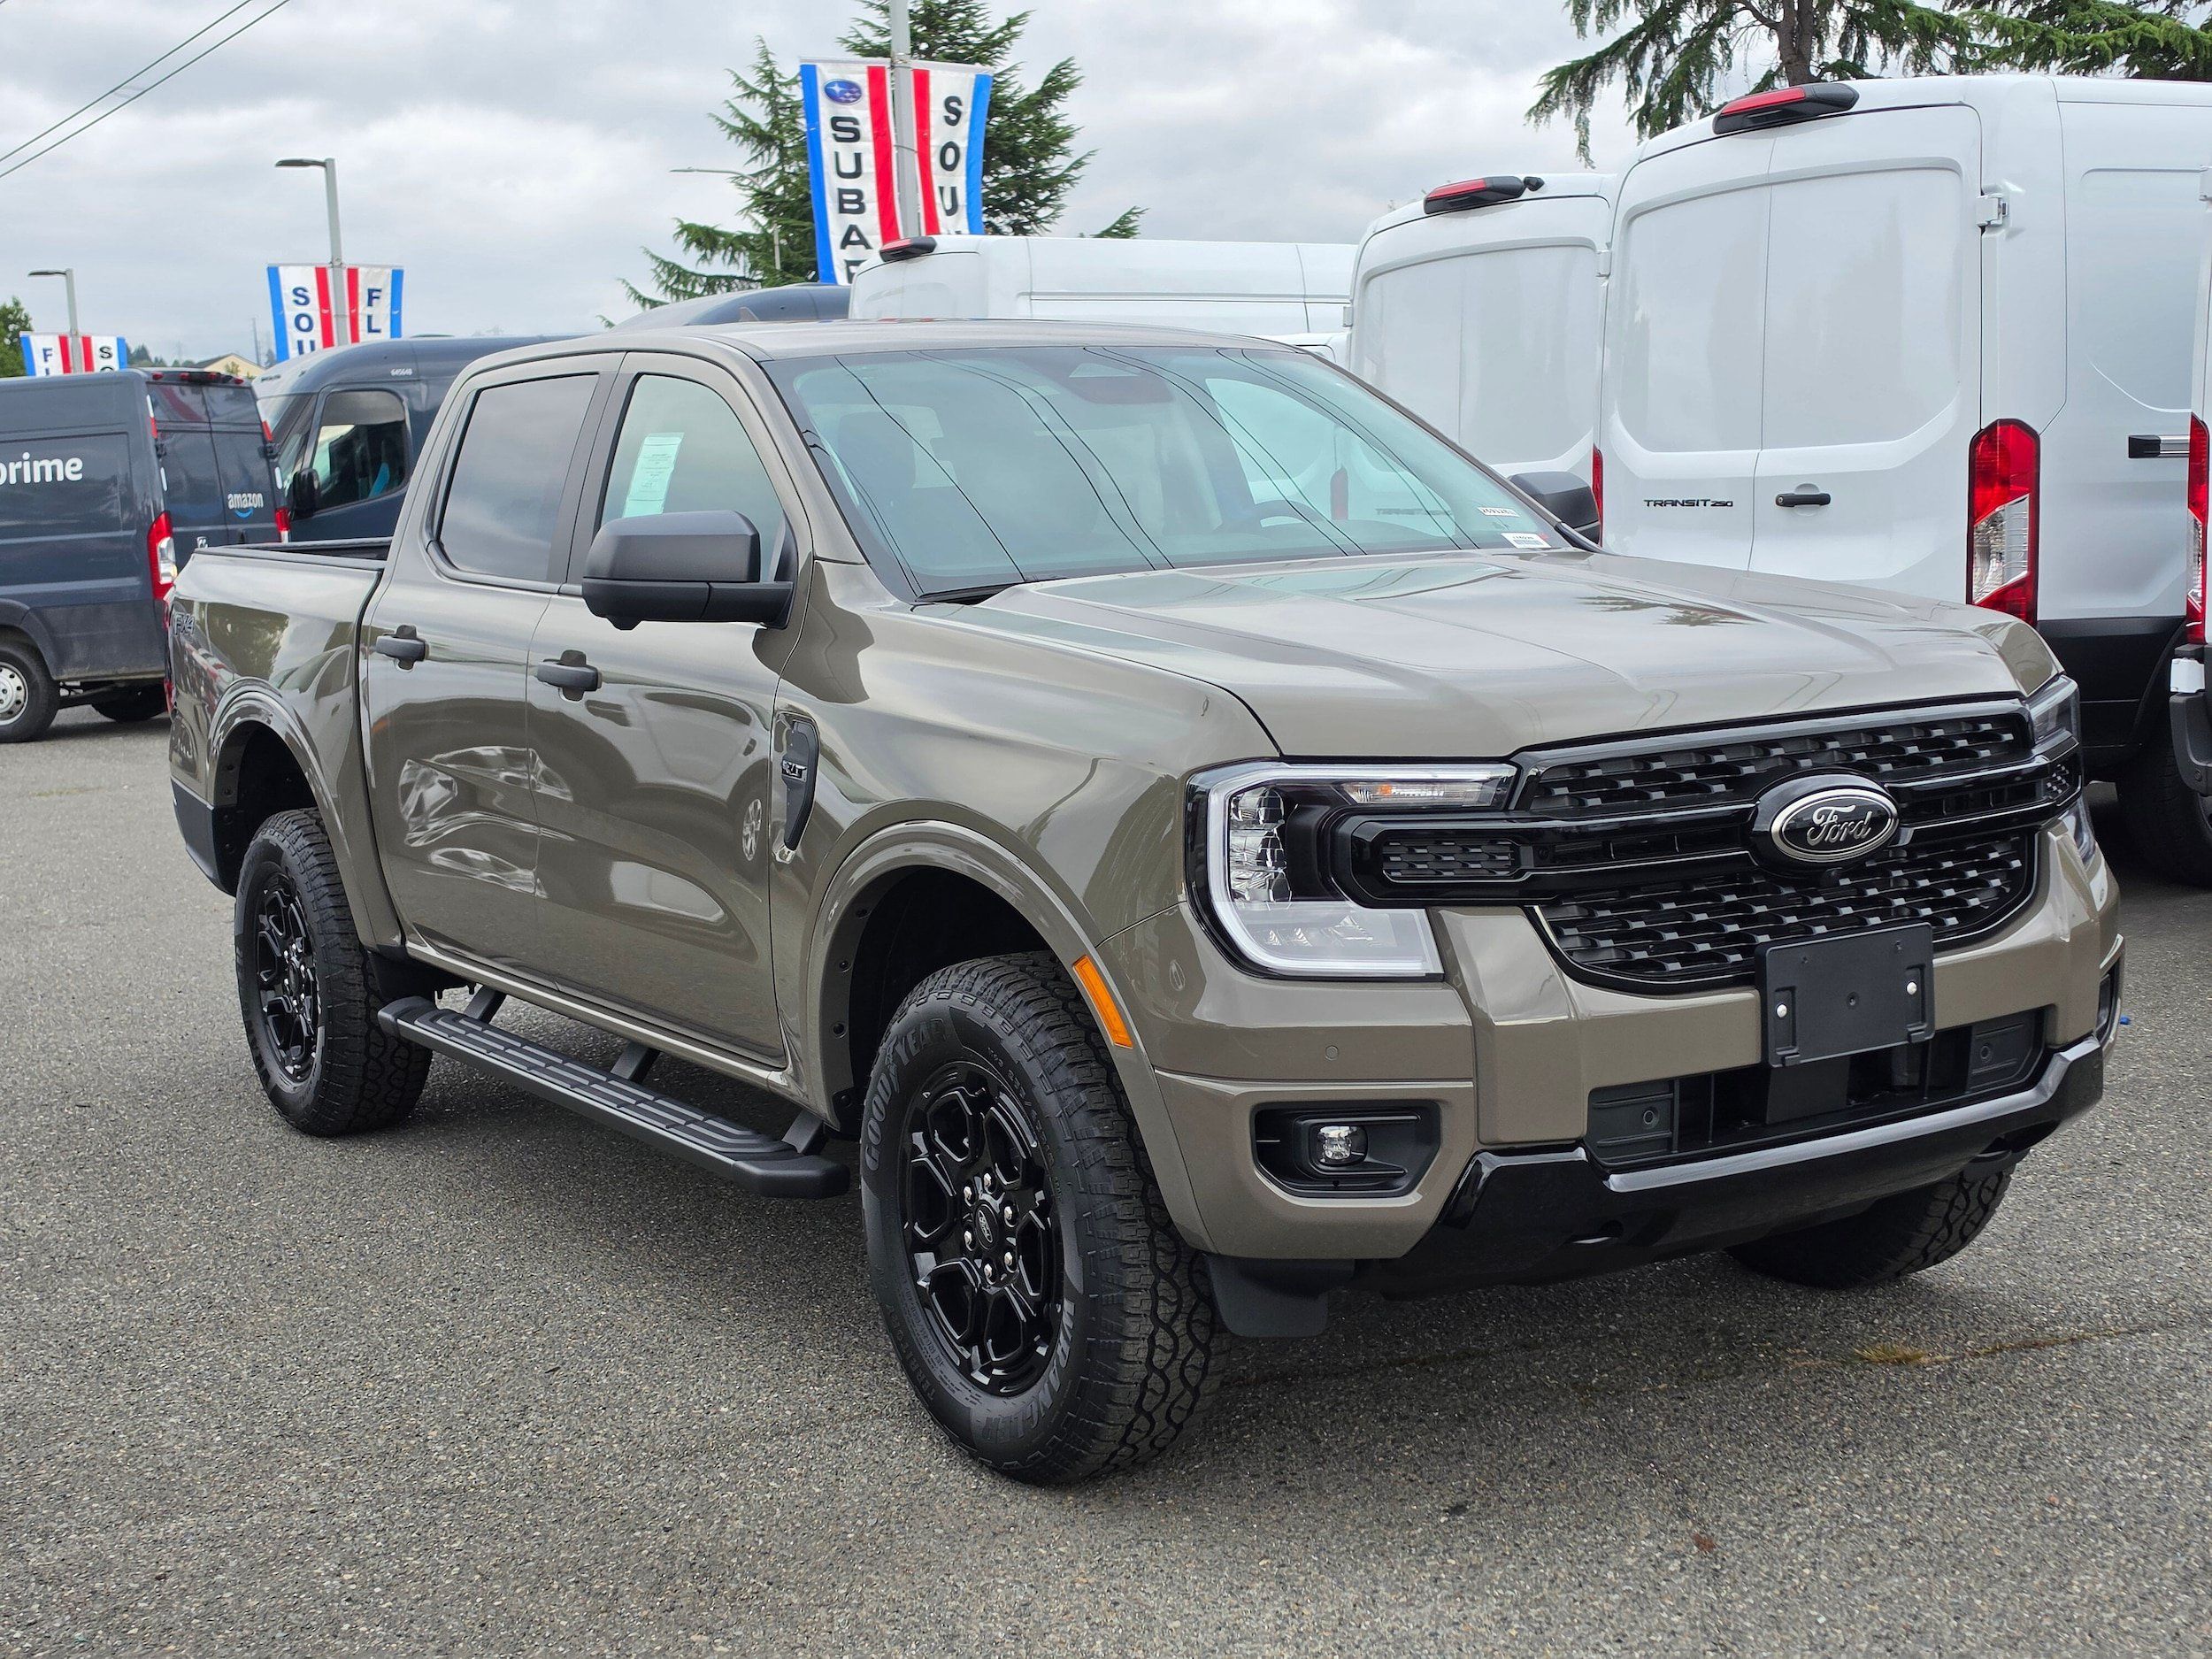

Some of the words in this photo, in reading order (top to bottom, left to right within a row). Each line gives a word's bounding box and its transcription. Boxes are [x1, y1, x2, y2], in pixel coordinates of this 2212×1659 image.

[940, 96, 963, 234] SOU
[227, 493, 264, 510] amazon
[1807, 804, 1873, 846] Ford
